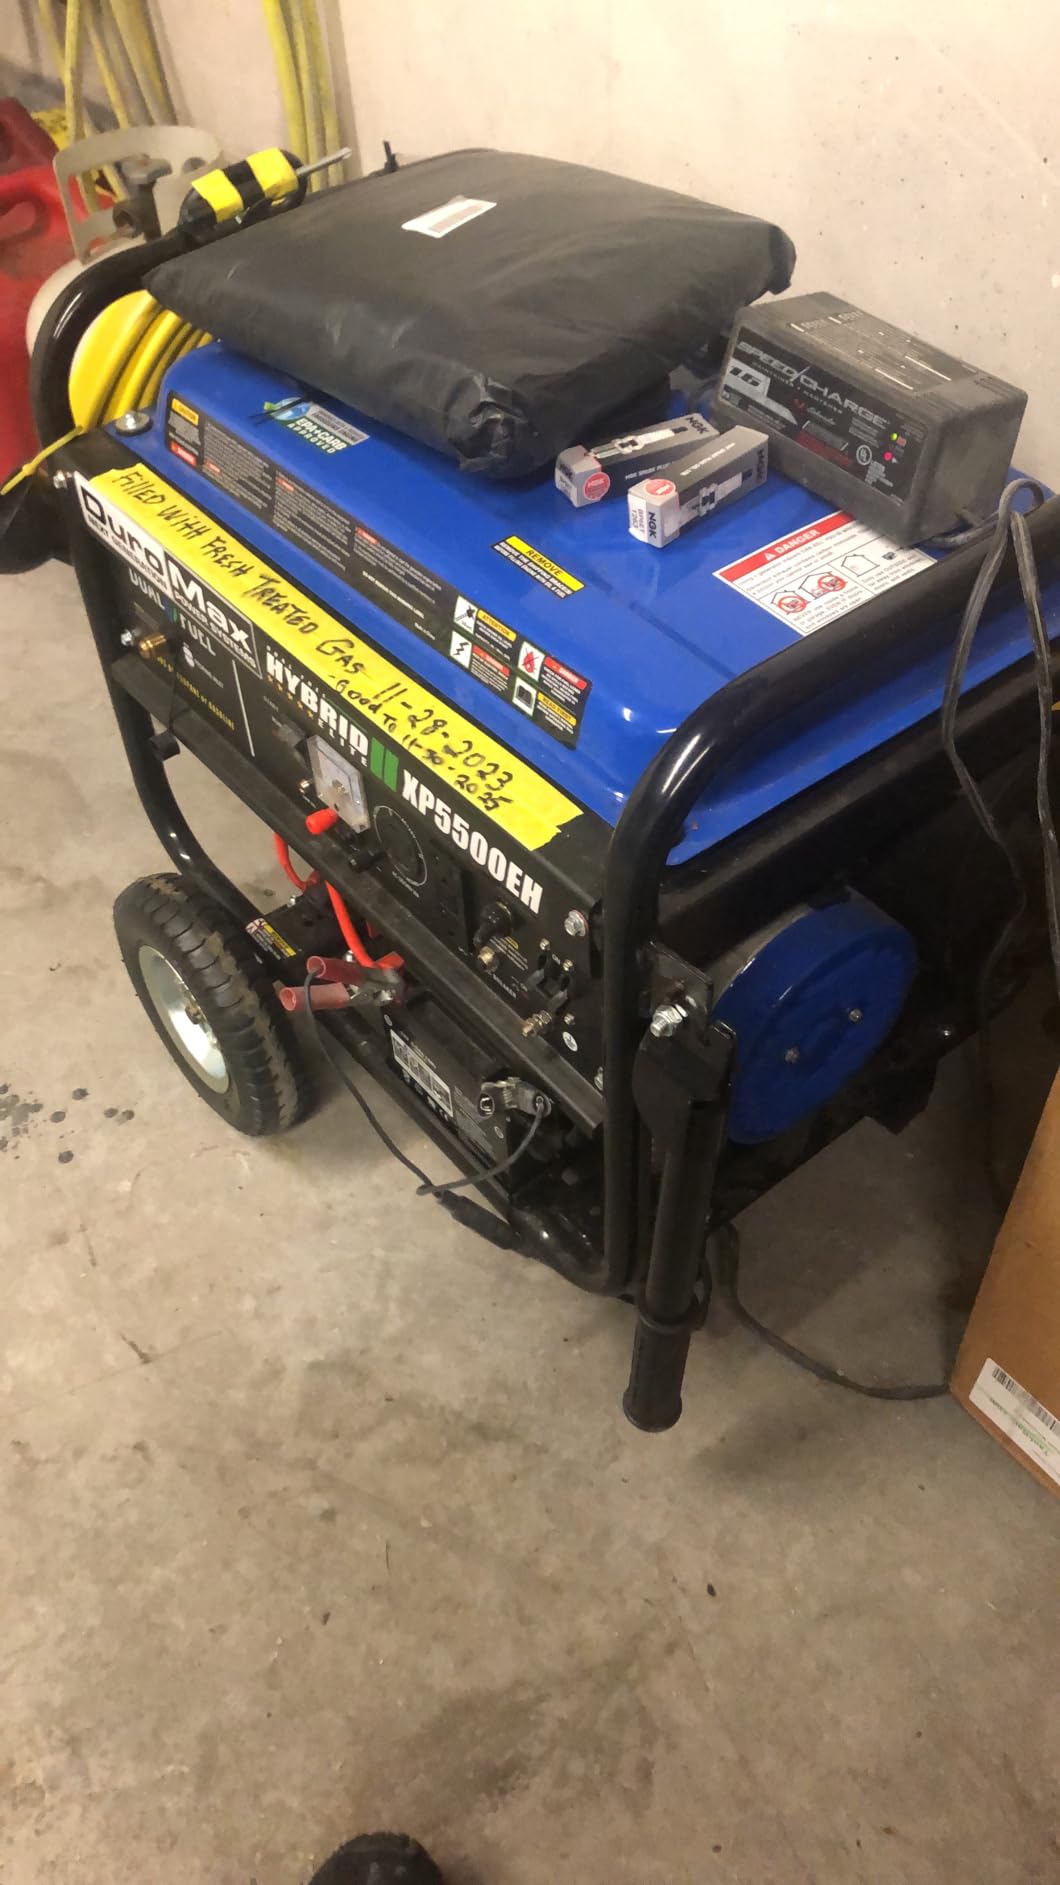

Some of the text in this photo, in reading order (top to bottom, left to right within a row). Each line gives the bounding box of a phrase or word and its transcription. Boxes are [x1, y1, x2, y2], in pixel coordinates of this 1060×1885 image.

[287, 423, 337, 454] APPROVED
[686, 416, 710, 435] NGK
[648, 511, 656, 539] NGK
[774, 529, 820, 554] DANGER
[525, 549, 563, 577] REMOVE
[200, 536, 254, 577] FRESH
[241, 573, 319, 634] TREATED
[174, 591, 209, 626] POWER
[209, 621, 258, 670] SYSTEMS
[266, 652, 369, 756] HYBRID
[317, 718, 368, 767] ELITE
[402, 768, 544, 915] XP5500EH
